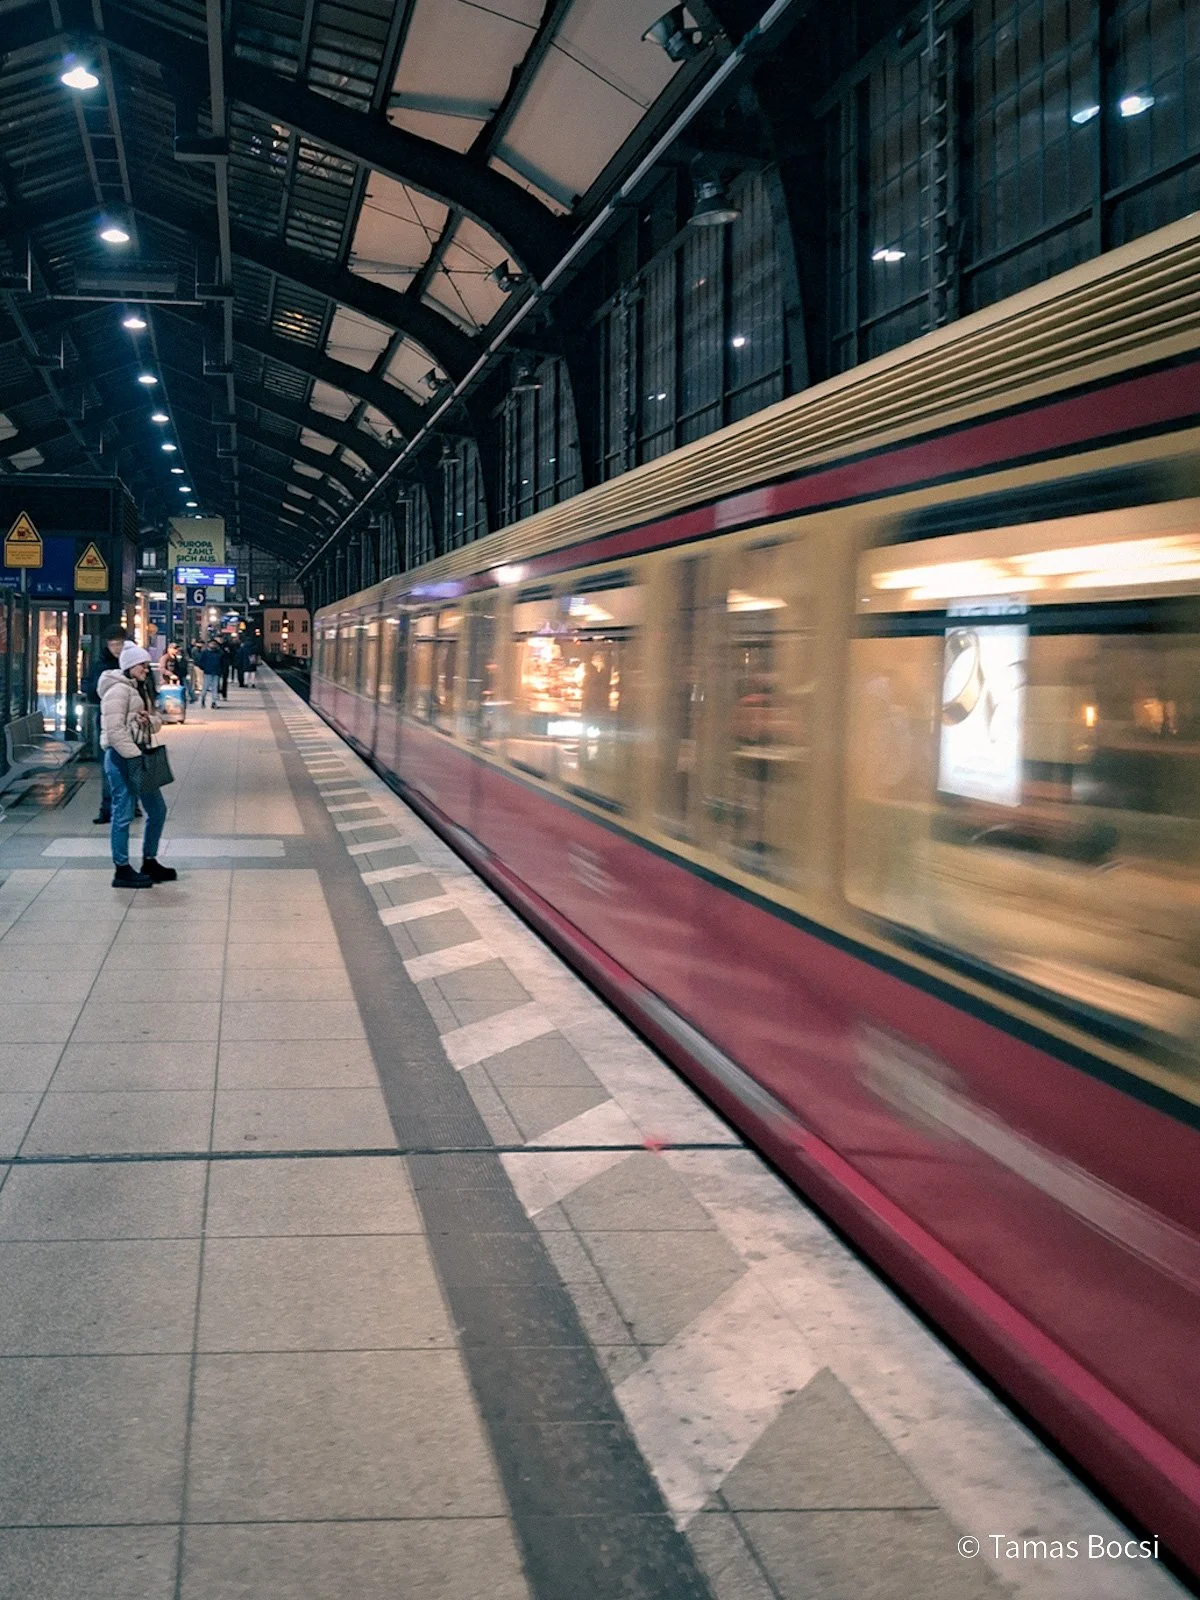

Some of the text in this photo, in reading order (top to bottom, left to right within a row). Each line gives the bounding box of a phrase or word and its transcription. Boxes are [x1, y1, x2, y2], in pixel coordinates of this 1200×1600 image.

[176, 554, 216, 562] SICH AUS
[193, 588, 205, 604] 6
